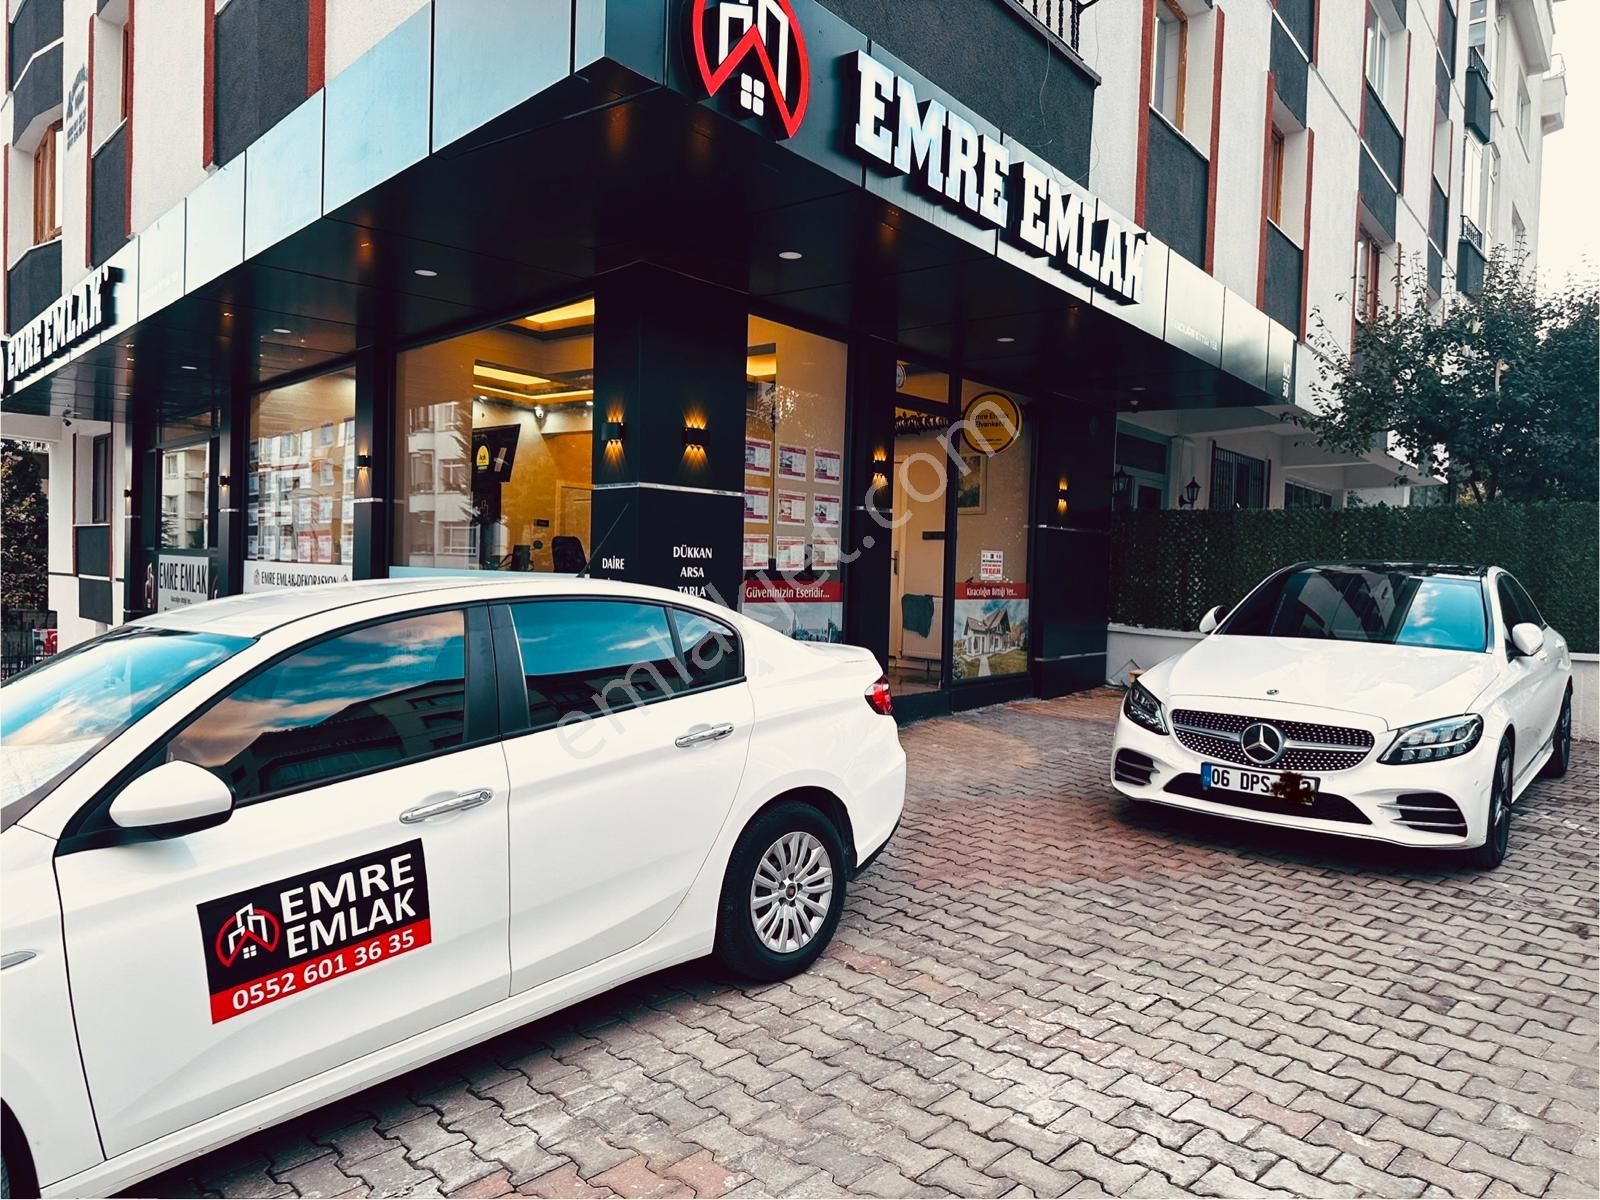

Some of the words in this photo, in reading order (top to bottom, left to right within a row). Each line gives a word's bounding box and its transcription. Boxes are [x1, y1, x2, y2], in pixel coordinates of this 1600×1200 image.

[855, 49, 1010, 229] EMRE
[7, 319, 42, 381] EMRE
[602, 555, 625, 570] DAİRE
[673, 544, 713, 559] DÜKKAN
[680, 566, 705, 578] ARSA
[159, 562, 179, 590] EMRE
[180, 564, 208, 595] EMLAK
[1211, 768, 1230, 787] 06
[1240, 772, 1270, 793] DPS
[280, 853, 415, 924] EMRE
[286, 888, 416, 959] EMLAK
[232, 972, 297, 1011] 0552
[303, 954, 348, 984] 601
[354, 941, 382, 967] 36
[388, 929, 415, 954] 35
